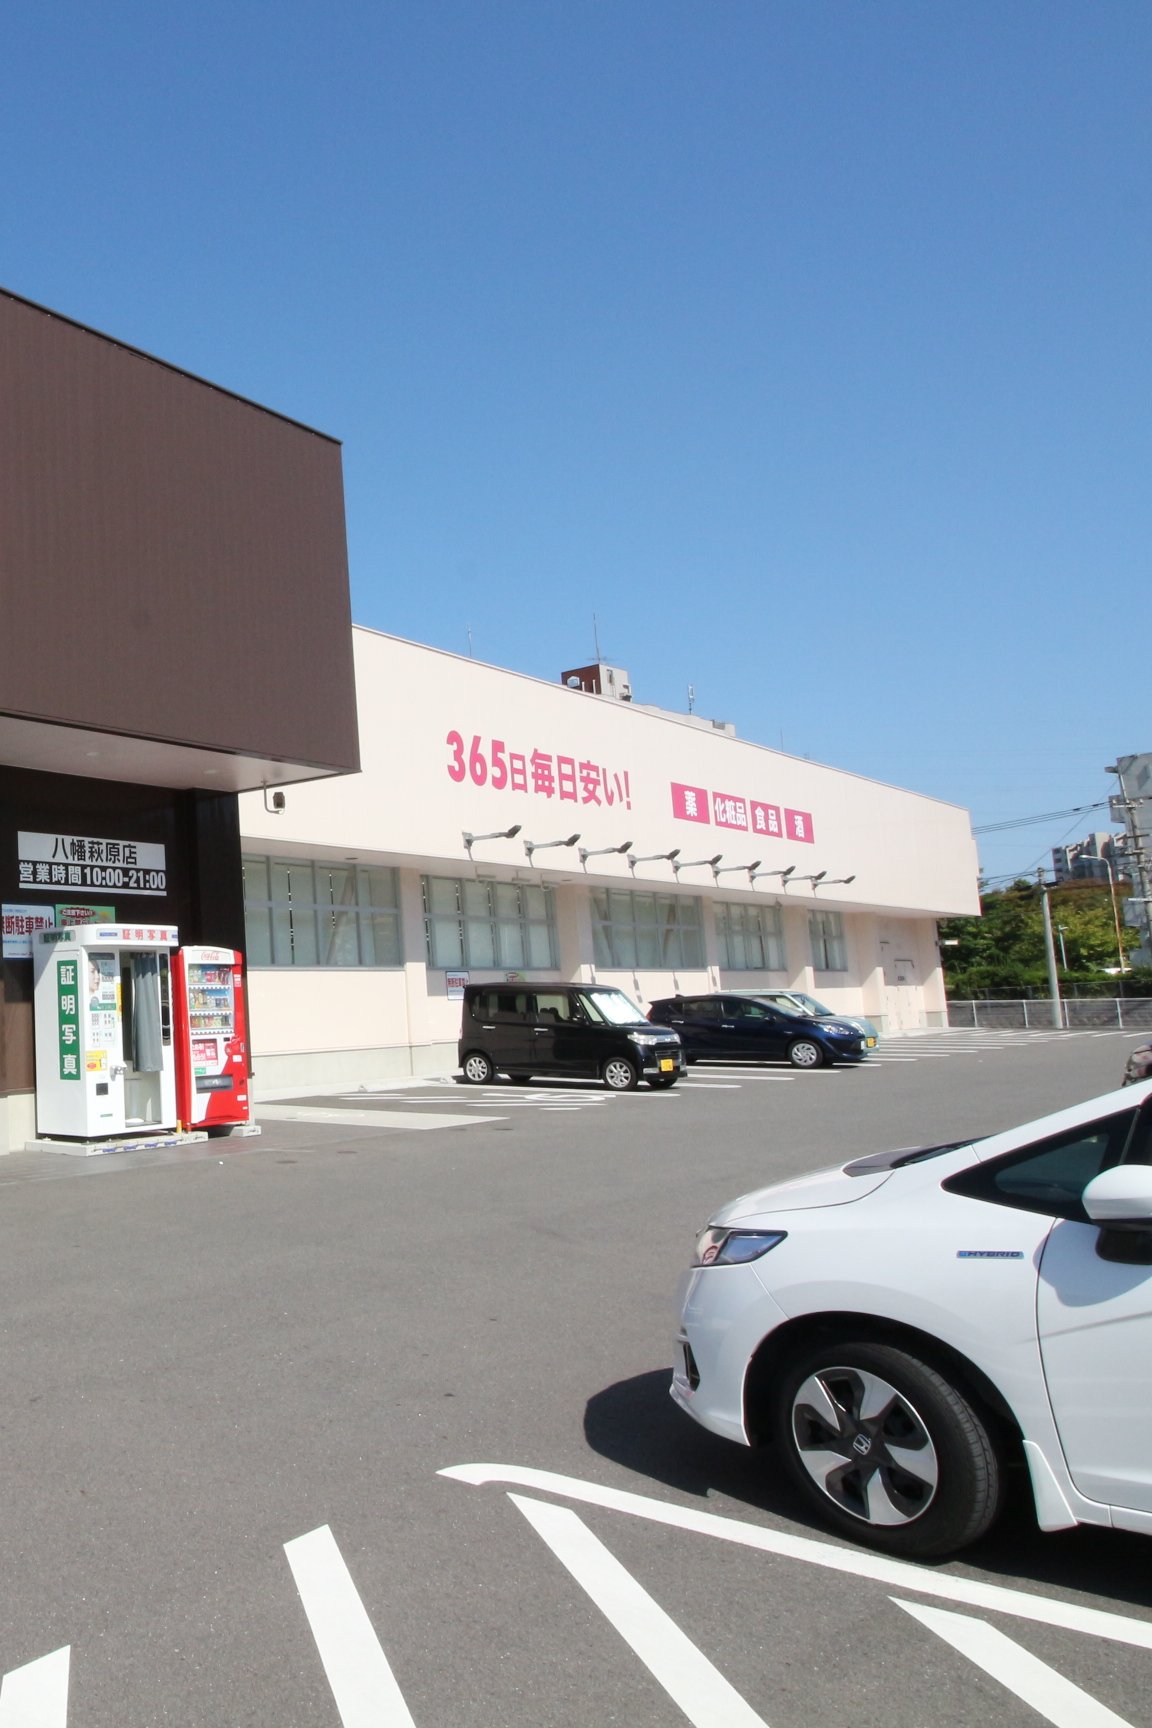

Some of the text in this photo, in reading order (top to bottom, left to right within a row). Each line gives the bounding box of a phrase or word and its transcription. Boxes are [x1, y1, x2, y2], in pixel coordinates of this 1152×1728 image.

[684, 790, 698, 817] 薬
[714, 797, 747, 827] 化粧品
[754, 806, 779, 833] 食品
[52, 837, 138, 866] 八幡萩原店
[122, 929, 168, 942] 証明写真
[59, 965, 79, 1075] 証明写真
